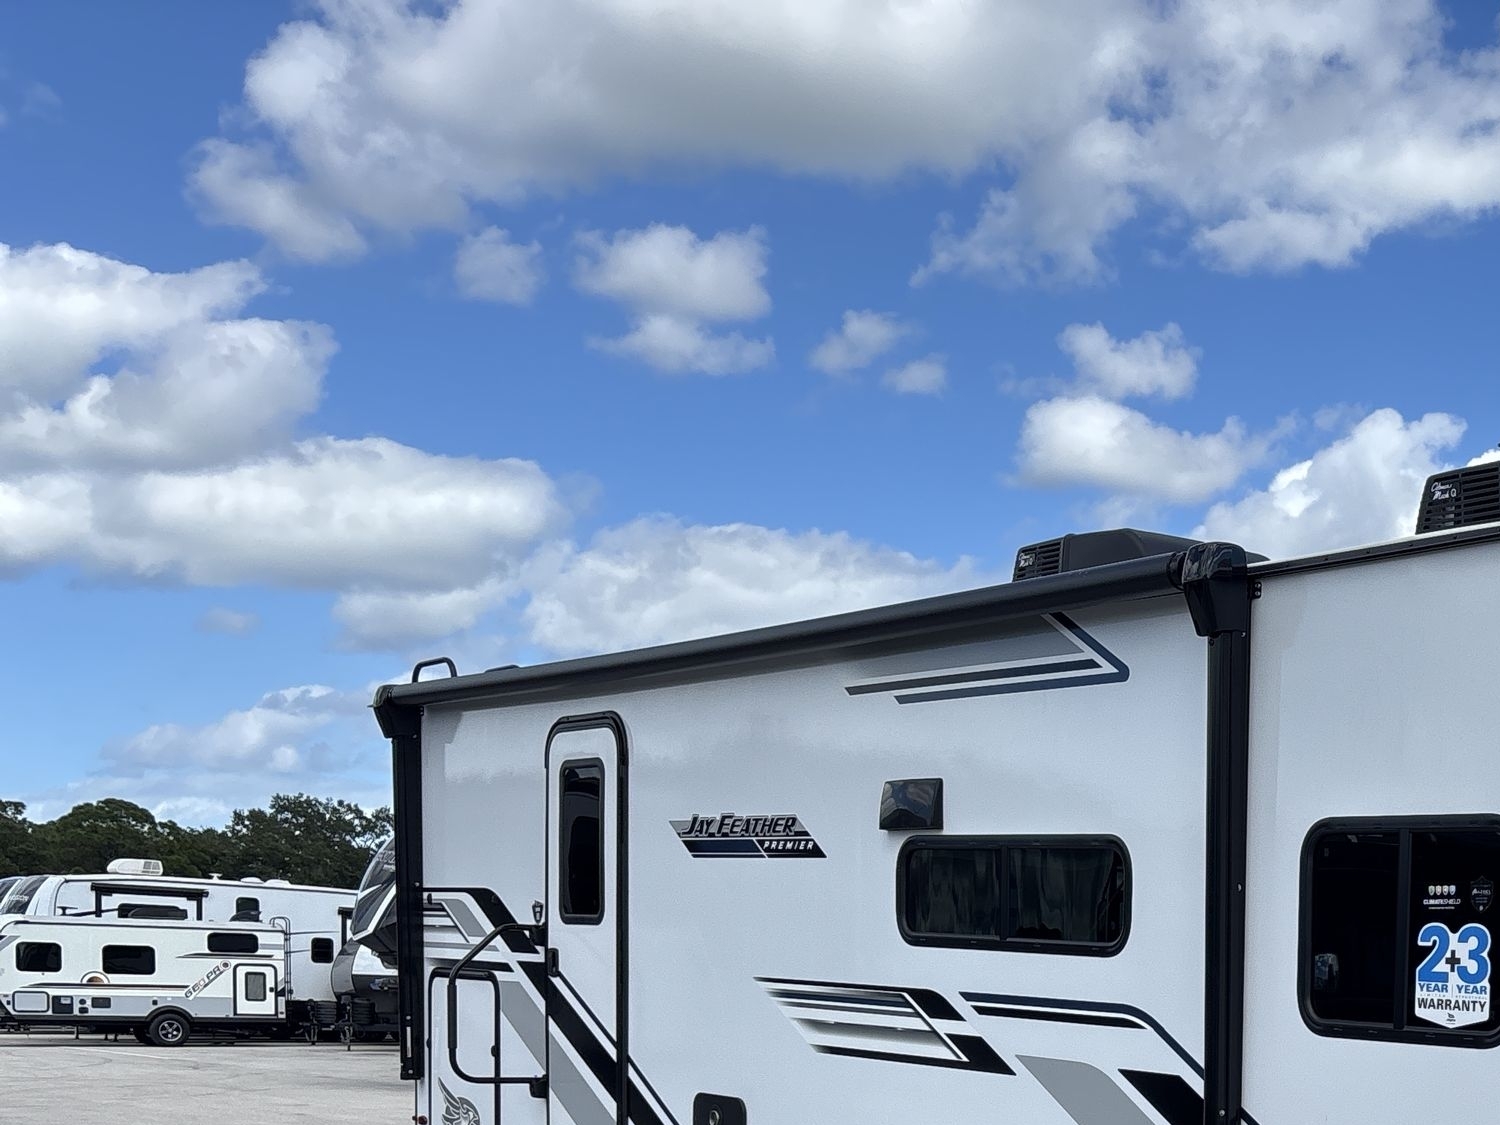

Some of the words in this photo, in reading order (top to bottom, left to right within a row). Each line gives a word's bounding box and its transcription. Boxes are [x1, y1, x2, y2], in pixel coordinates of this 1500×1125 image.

[763, 840, 814, 850] PREMIER
[185, 977, 206, 998] GEO
[206, 960, 231, 980] PRO
[1418, 983, 1448, 993] YEAR
[1456, 984, 1487, 995] YEAR
[1418, 998, 1487, 1012] WARRANTY
